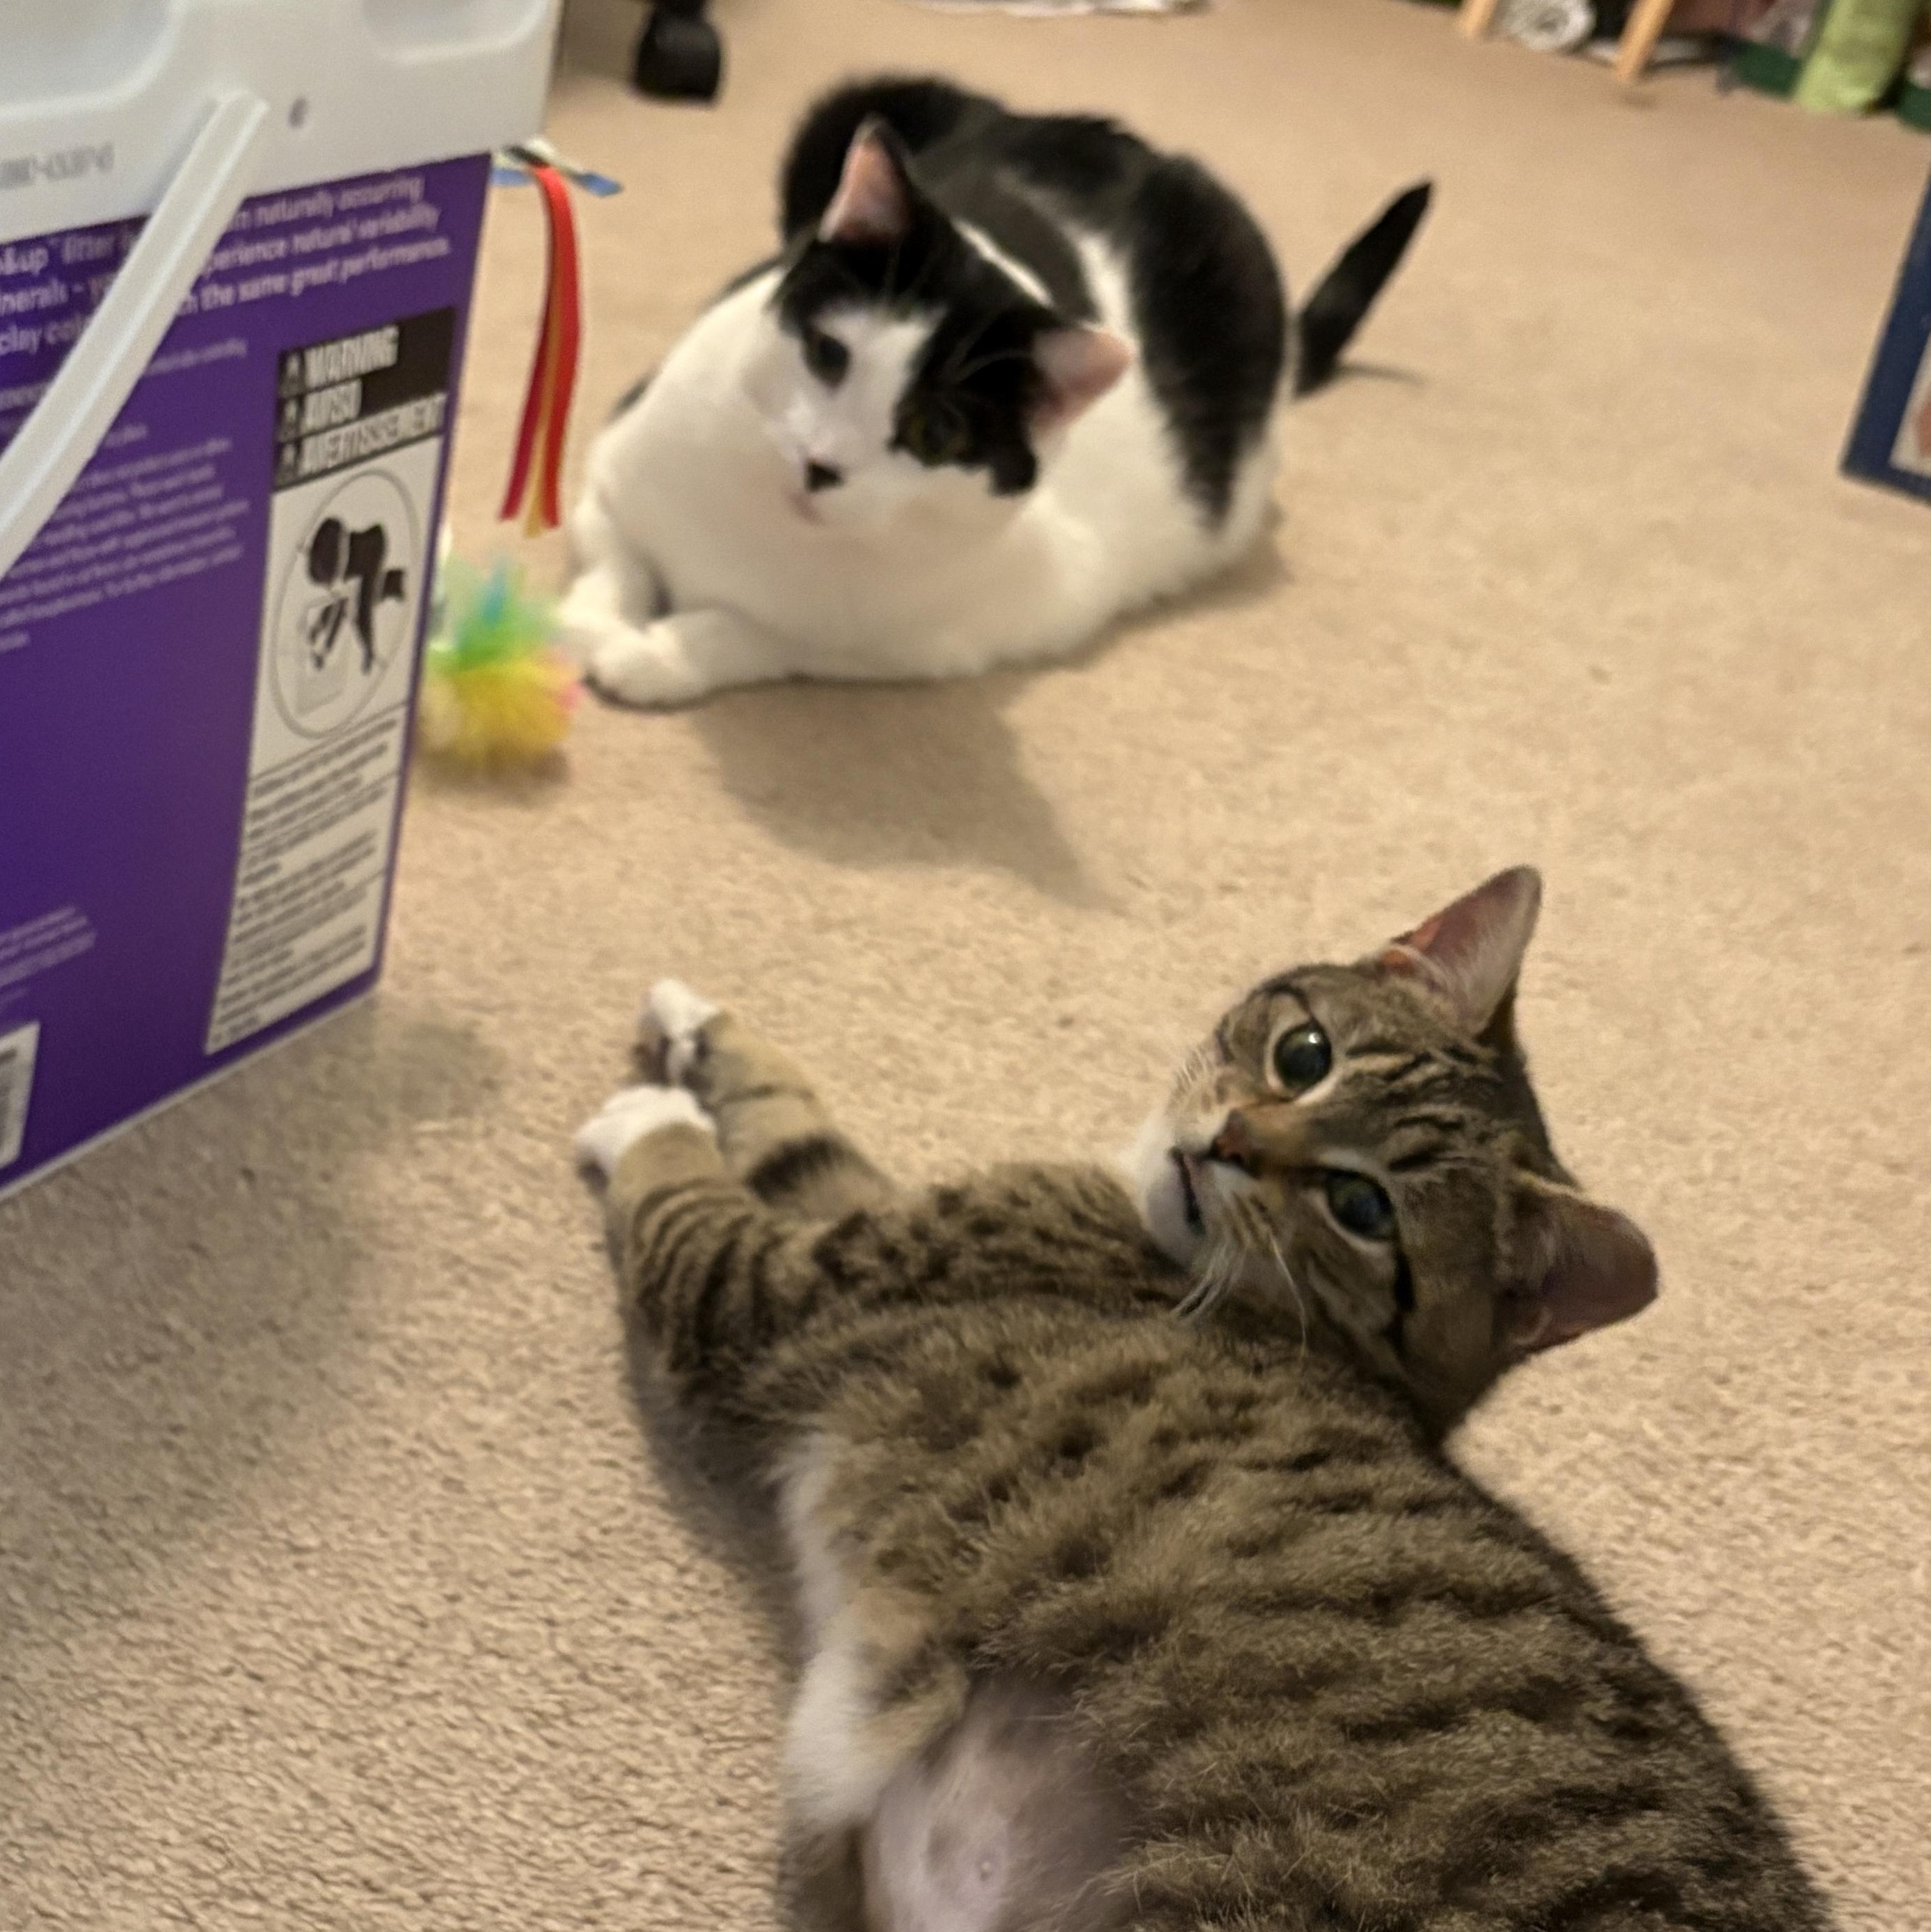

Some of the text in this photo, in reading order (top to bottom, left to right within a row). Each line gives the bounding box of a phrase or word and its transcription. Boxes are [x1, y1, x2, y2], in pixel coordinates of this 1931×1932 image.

[253, 190, 333, 226] naturally
[339, 176, 426, 210] occurring
[0, 277, 68, 313] nerals
[206, 238, 286, 276] perience
[290, 219, 358, 255] natural
[200, 283, 235, 311] the
[238, 274, 286, 302] same
[290, 258, 337, 296] great
[304, 325, 399, 388] WARNING
[301, 379, 362, 434] AVISO
